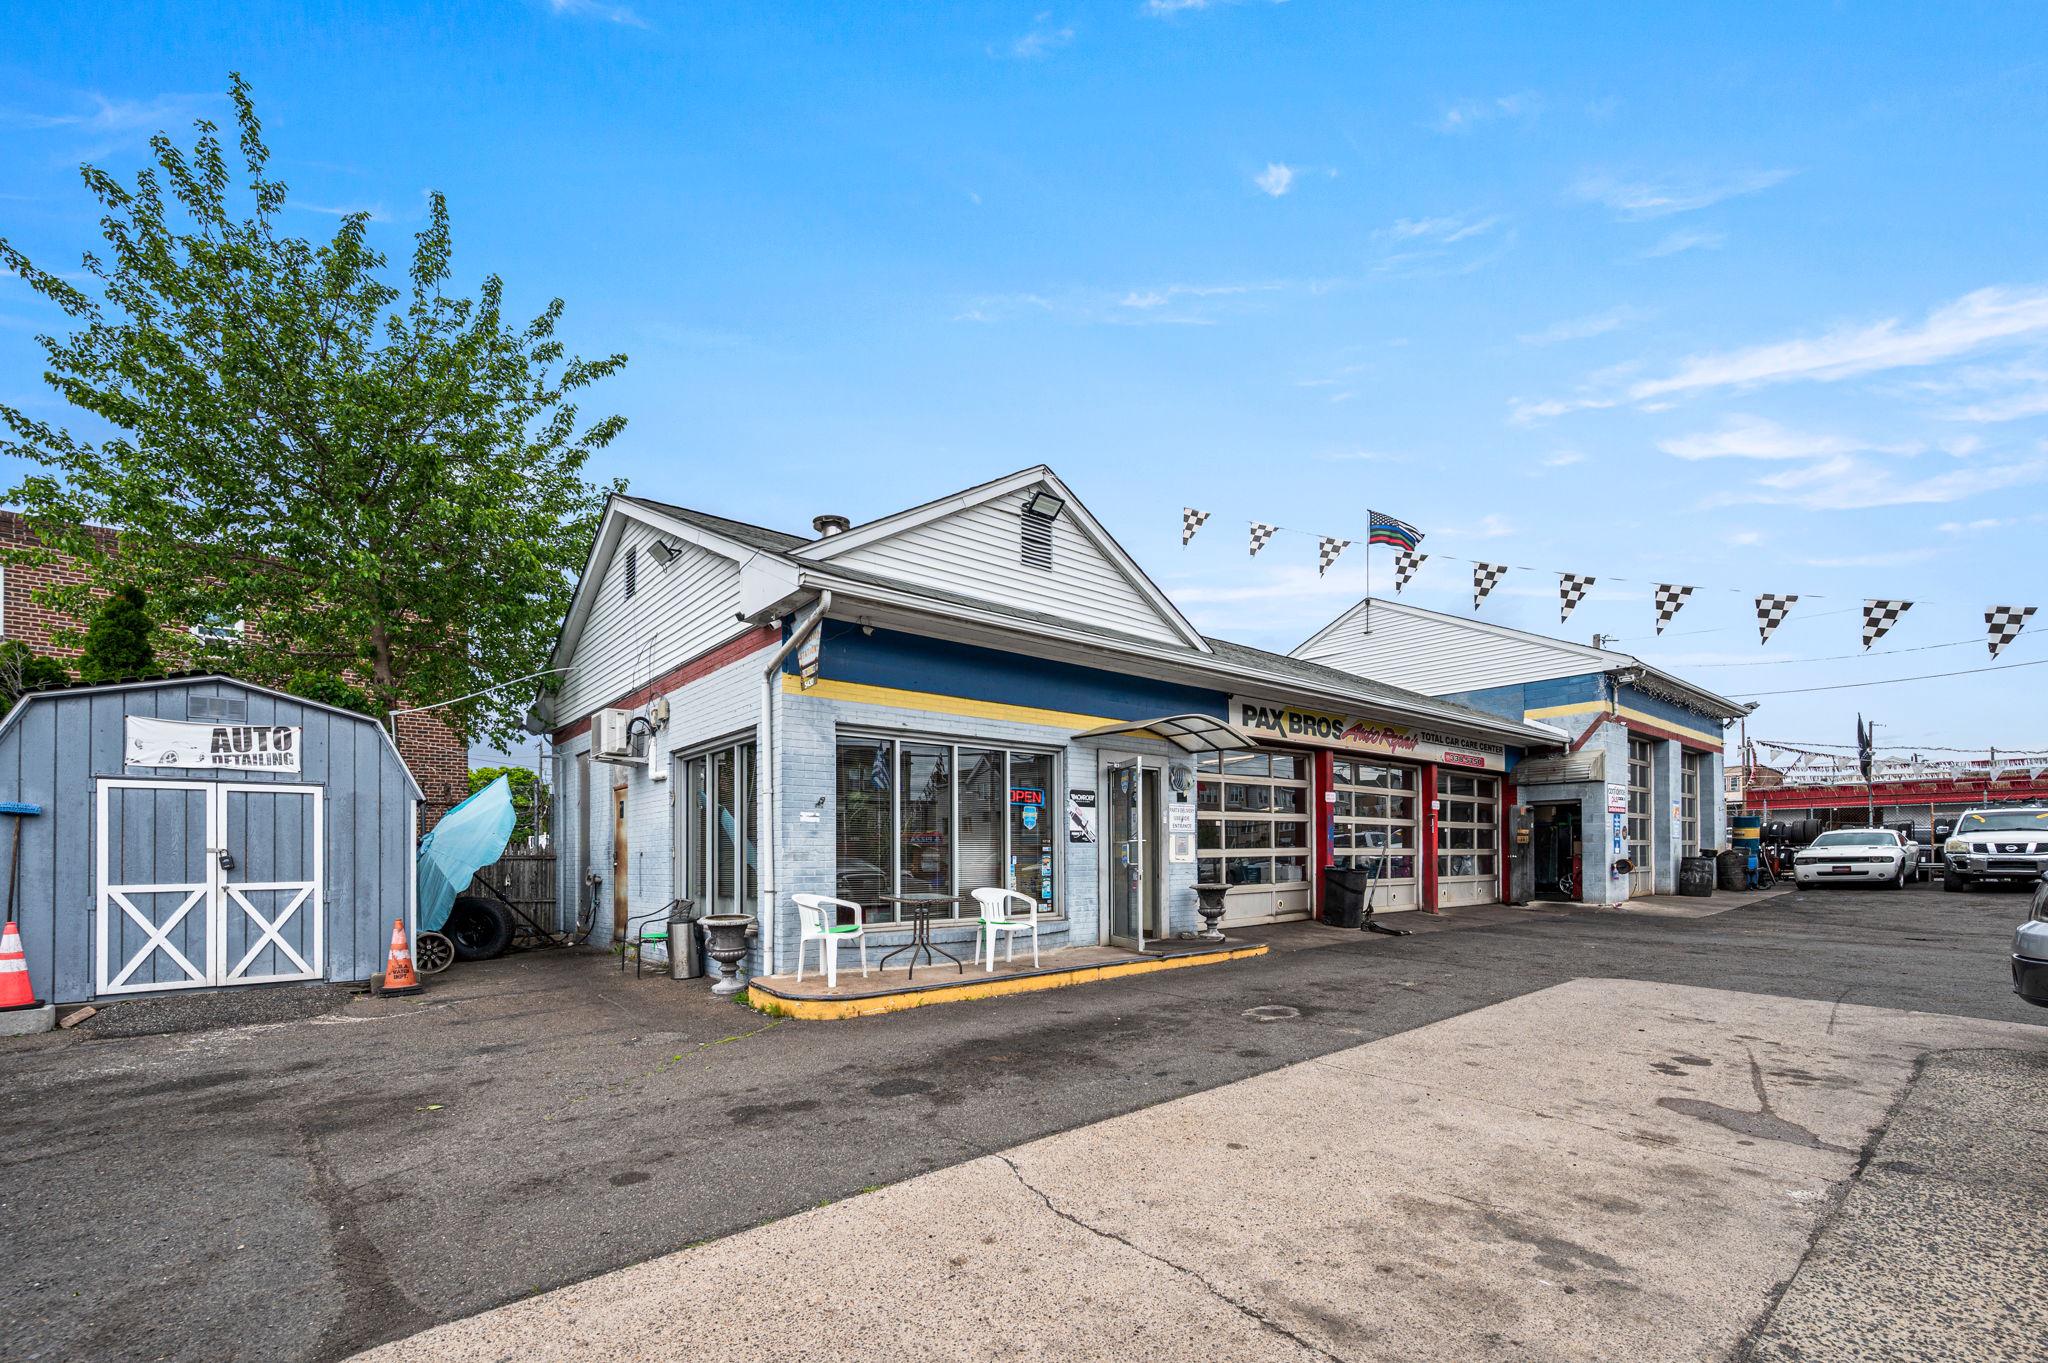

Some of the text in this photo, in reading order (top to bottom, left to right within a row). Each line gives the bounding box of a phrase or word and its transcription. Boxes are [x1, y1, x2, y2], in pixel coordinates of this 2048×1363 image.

[210, 726, 293, 753] AUTO
[1242, 703, 1420, 754] PAX BROS Auto Repair
[1421, 731, 1444, 744] TOTAL
[1445, 736, 1460, 746] CAR
[1460, 739, 1479, 750] CARE
[1480, 742, 1504, 754] CENTER
[211, 752, 294, 766] DETAILING
[1010, 790, 1042, 804] OPEN
